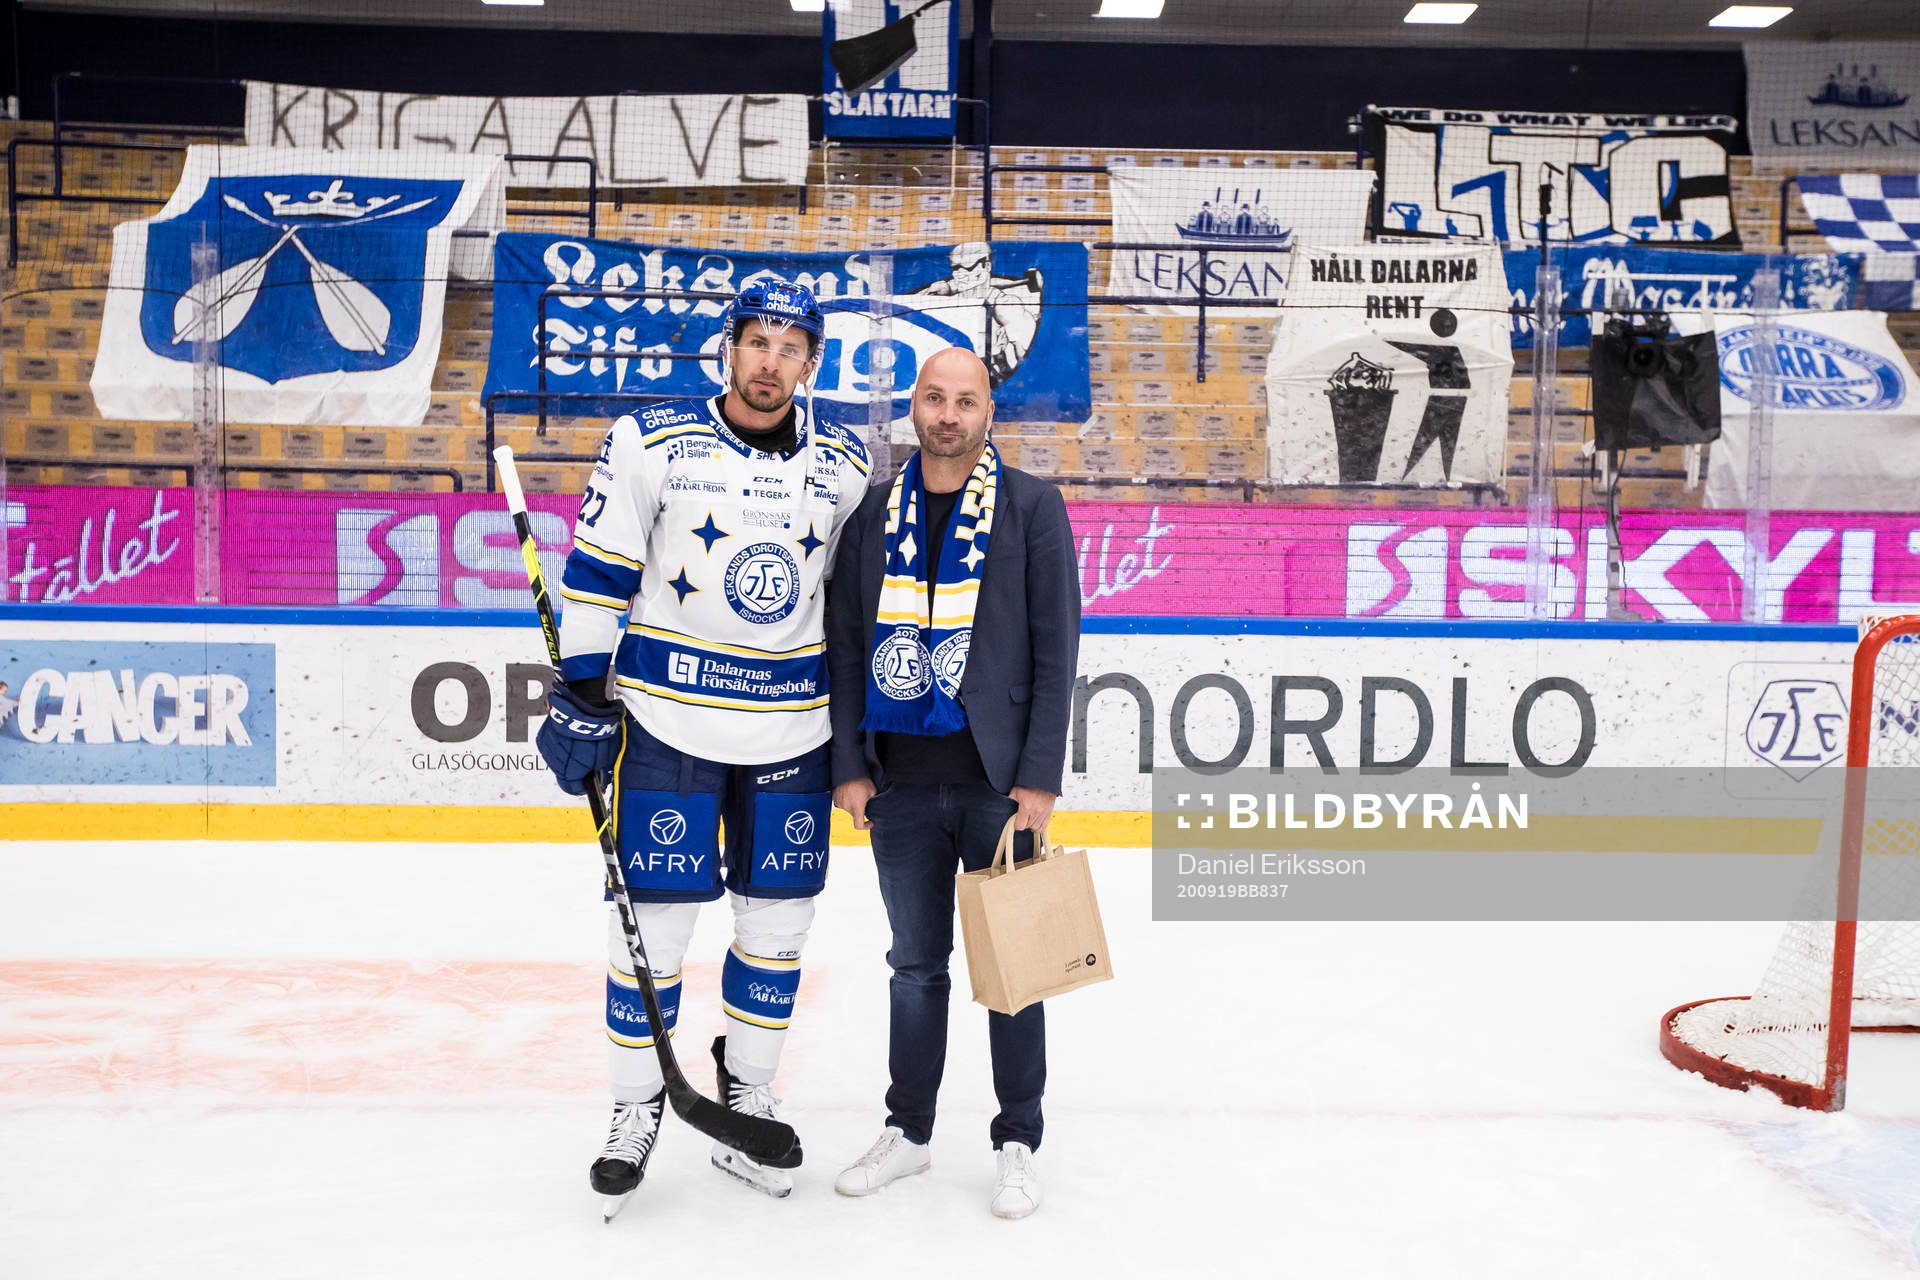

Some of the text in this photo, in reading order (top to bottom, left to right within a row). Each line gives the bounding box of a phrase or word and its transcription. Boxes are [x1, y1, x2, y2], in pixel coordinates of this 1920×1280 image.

[1382, 108, 1732, 130] WE DO WHAT WE LIKE
[1310, 252, 1478, 283] HÅLL DALARNA
[766, 301, 803, 314] ohlson
[767, 291, 791, 303] clas
[1366, 295, 1425, 319] RENT
[642, 408, 675, 420] clas
[646, 413, 698, 429] ohlson
[715, 425, 746, 451] TEGERA
[687, 450, 711, 459] Siljan
[670, 483, 681, 491] AB
[703, 483, 727, 493] HEDIN
[753, 476, 783, 485] CCM
[753, 489, 791, 500] TEGERA
[577, 486, 607, 528] 27
[725, 550, 750, 602] LEKSANDS
[1458, 526, 1920, 624] SKYL
[738, 608, 787, 624] ISHOCKEY
[540, 613, 558, 660] SUPER
[702, 659, 772, 681] Dalarnas
[18, 668, 253, 747] CANCER
[550, 705, 621, 737] CCM
[756, 767, 800, 785] CCM
[628, 851, 706, 874] AFRY
[761, 850, 825, 871] AFRY
[753, 992, 769, 1003] AB
[613, 1008, 625, 1020] AB
[626, 1013, 649, 1023] KAR
